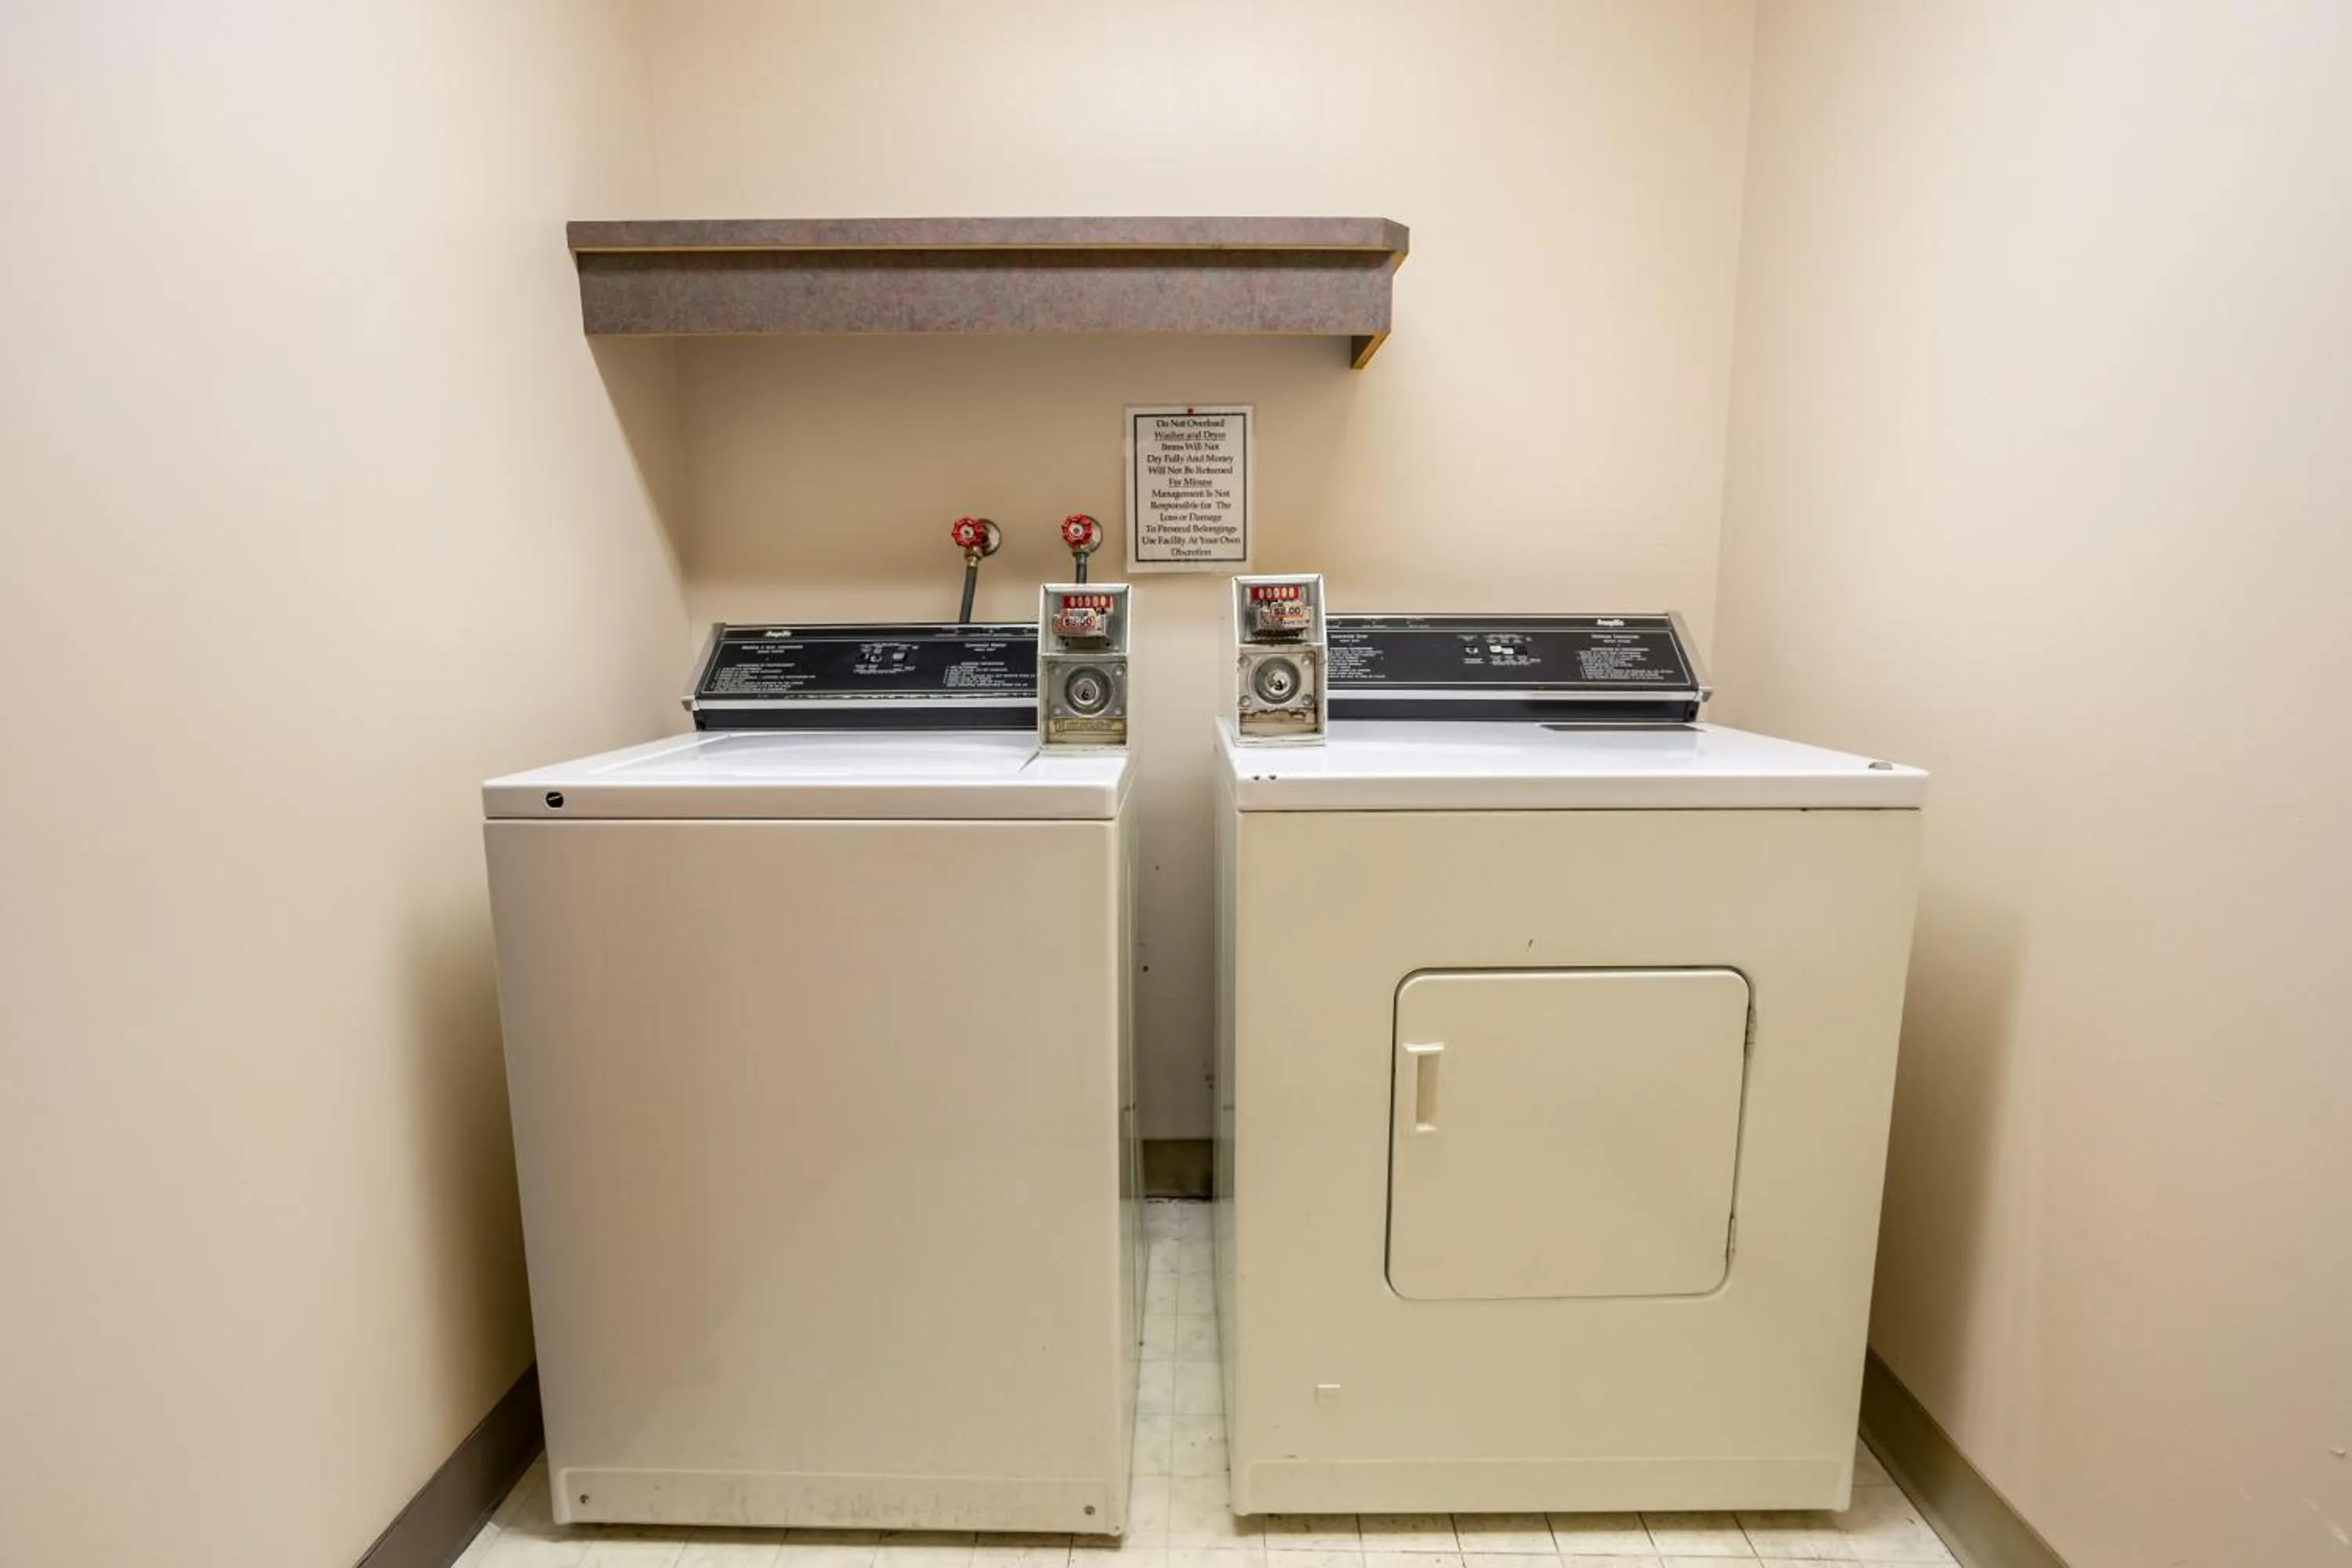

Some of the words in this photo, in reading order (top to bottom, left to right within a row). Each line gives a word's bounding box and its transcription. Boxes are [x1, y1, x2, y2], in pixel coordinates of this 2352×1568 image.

[1186, 418, 1225, 427] Overload
[1161, 442, 1184, 451] Items
[1185, 442, 1203, 451] Will
[1204, 442, 1219, 451] Not
[1147, 454, 1161, 464] Dry
[1164, 454, 1184, 464] Fully
[1186, 454, 1204, 463] And
[1206, 454, 1234, 464] Money
[1149, 466, 1165, 474] Will
[1167, 466, 1182, 474] Not
[1184, 466, 1194, 474] Be
[1196, 466, 1233, 474] Returned
[1169, 477, 1181, 486] For
[1152, 489, 1204, 499] Management
[1206, 489, 1213, 498] Is
[1214, 489, 1230, 498] Not
[1150, 501, 1200, 511] Responsible
[1216, 501, 1232, 510] The
[1189, 513, 1223, 523] Damage
[1145, 524, 1156, 533] To
[1158, 524, 1191, 533] Personal
[1192, 524, 1237, 535] Belongings
[1142, 536, 1157, 545] Use
[1158, 535, 1185, 546] Facility
[1189, 536, 1198, 545] At
[1200, 536, 1218, 545] Your
[1171, 548, 1211, 557] Discretion
